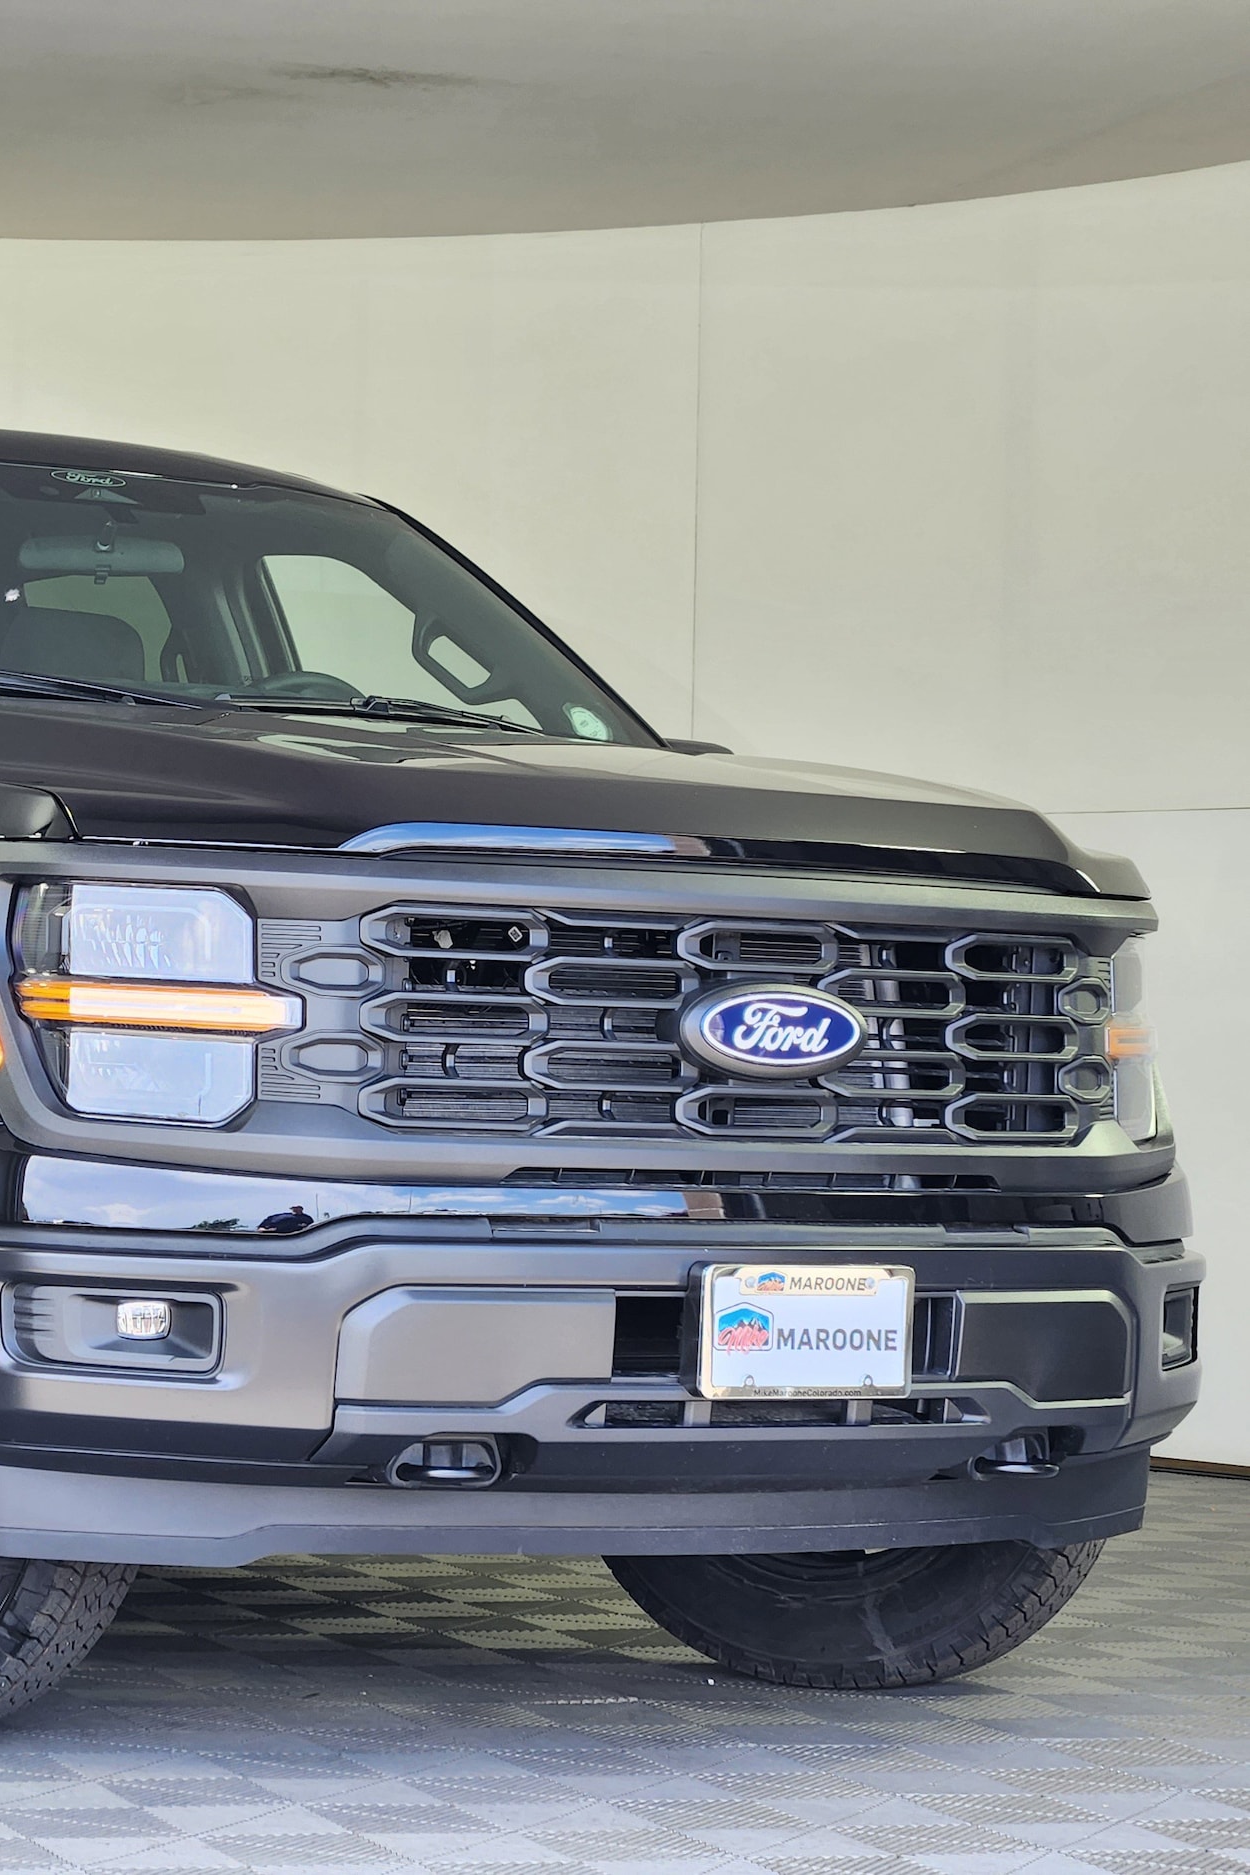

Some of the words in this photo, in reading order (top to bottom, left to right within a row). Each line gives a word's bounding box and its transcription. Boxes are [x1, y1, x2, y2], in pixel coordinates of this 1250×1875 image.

[66, 471, 114, 485] Ford
[732, 1002, 832, 1053] Ford
[789, 1277, 866, 1291] MAROONE
[777, 1328, 898, 1351] MAROONE
